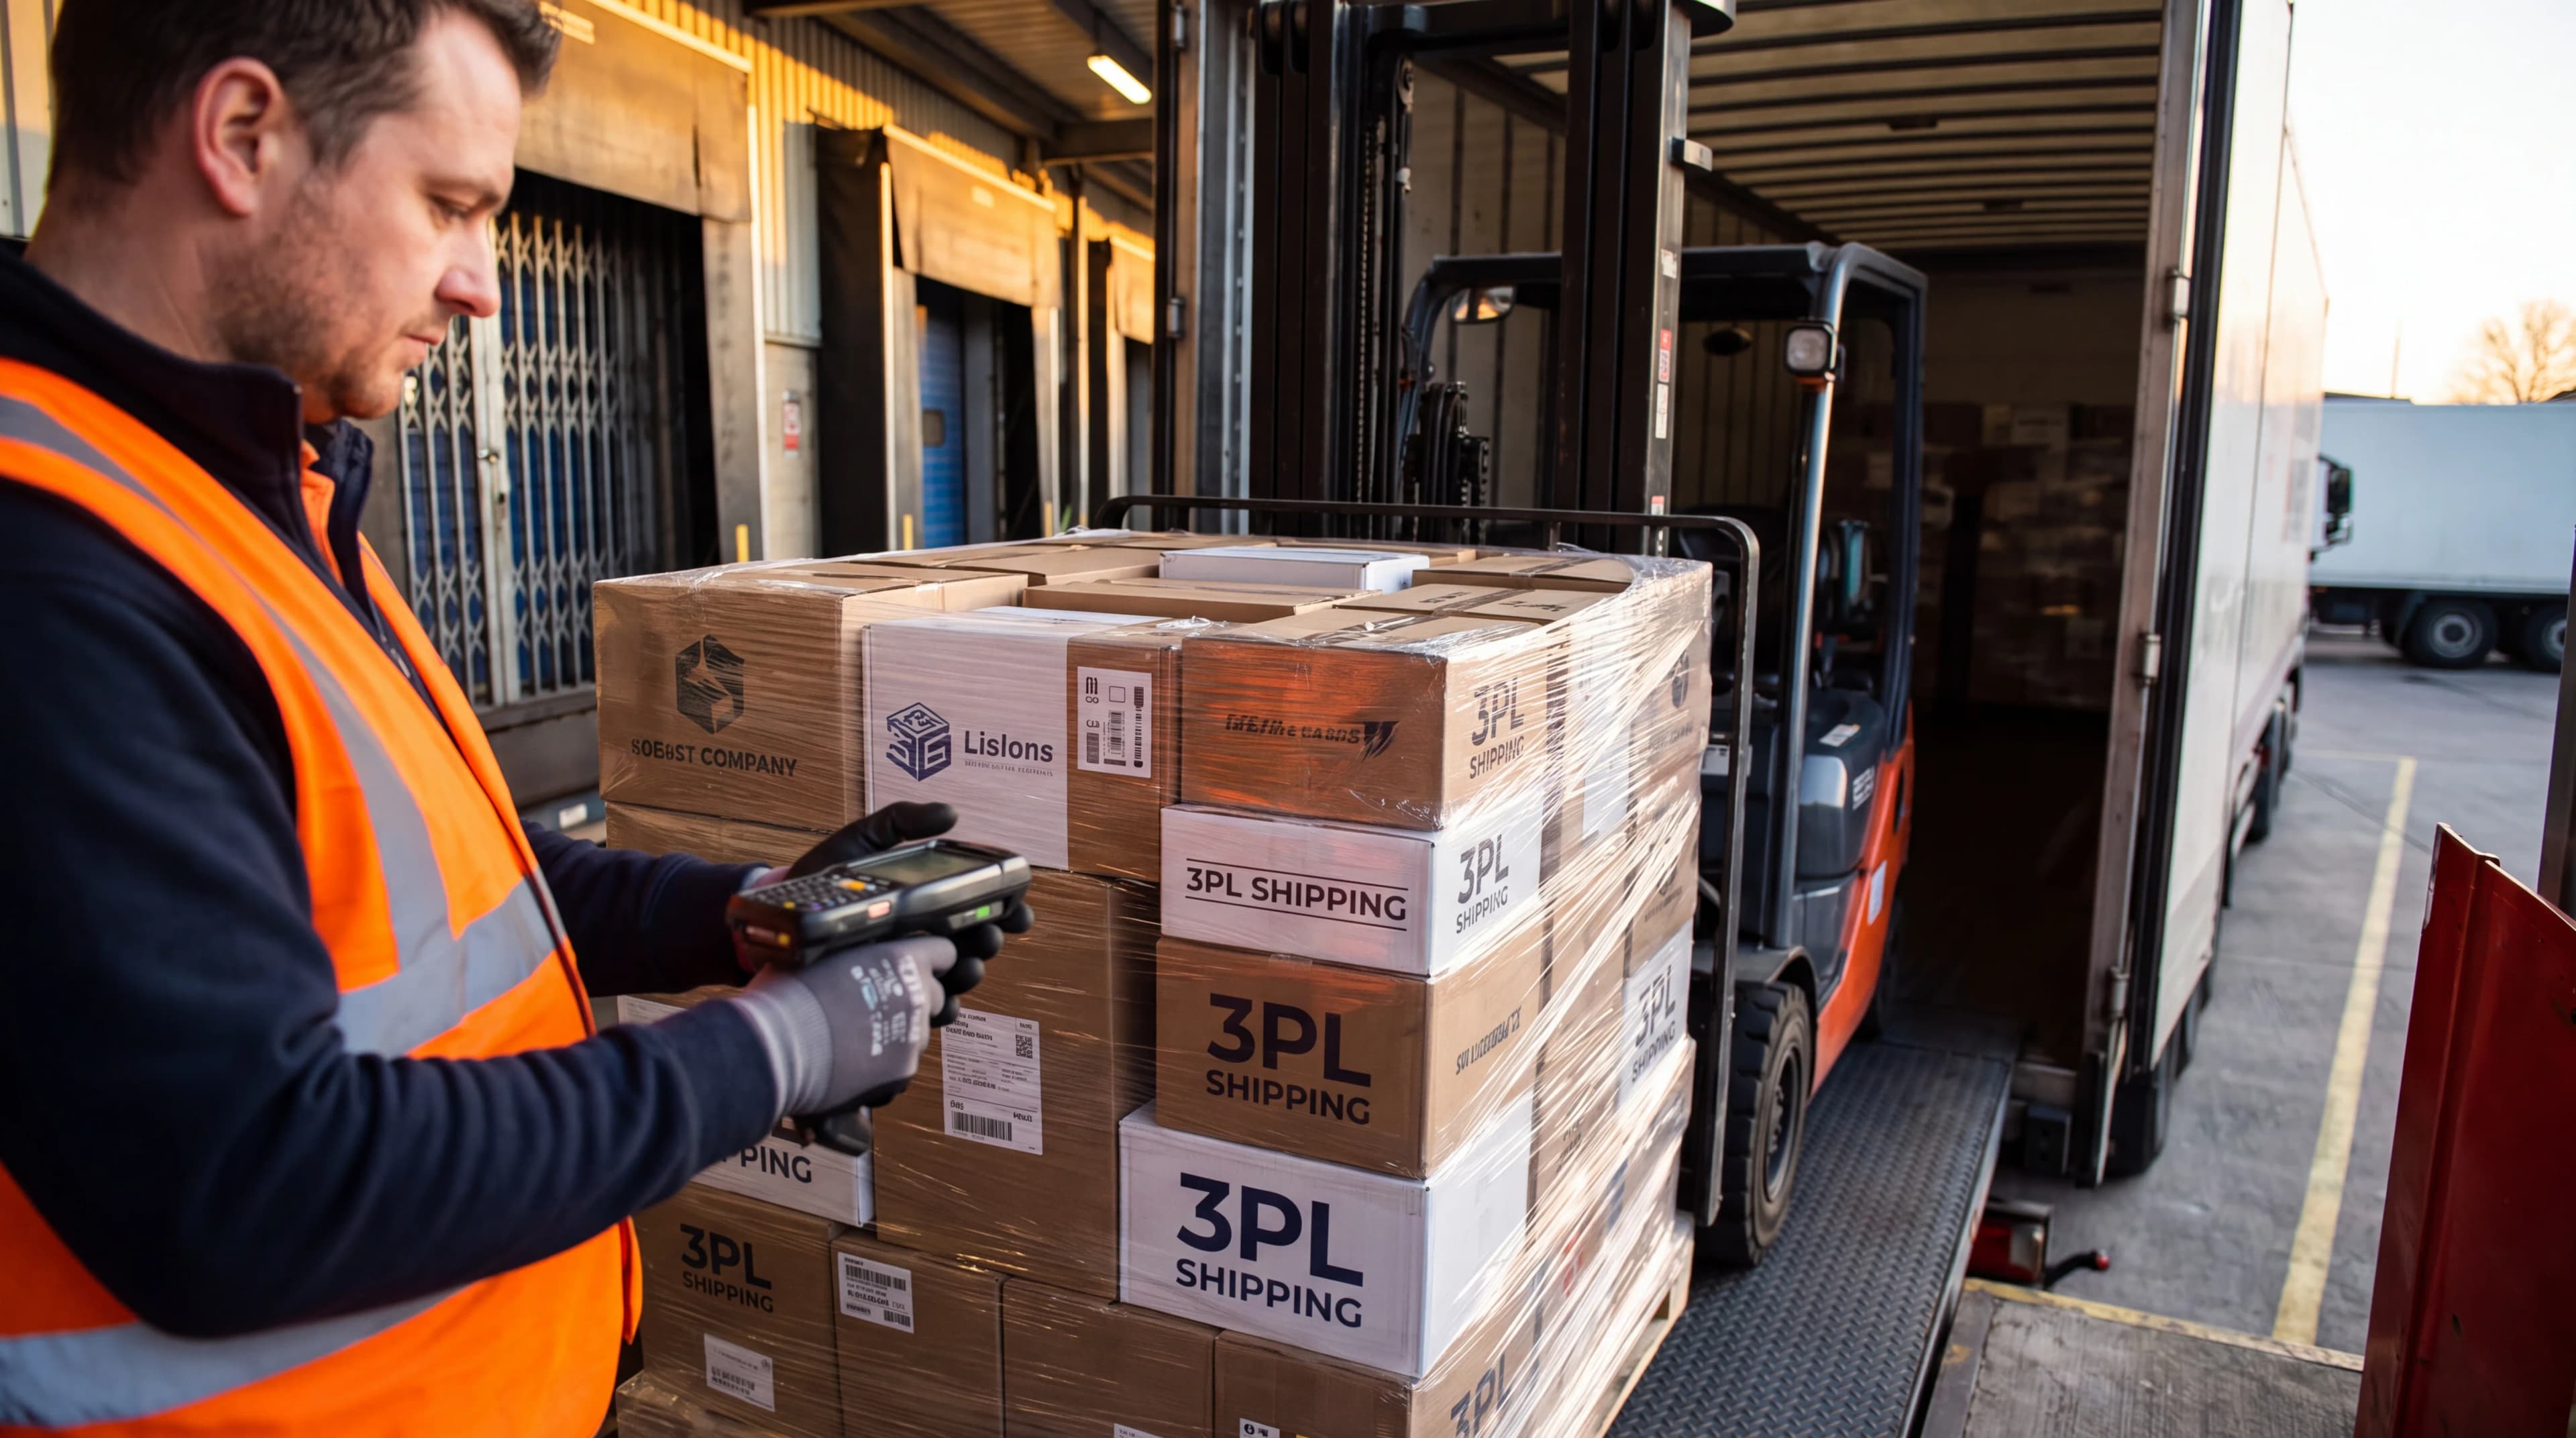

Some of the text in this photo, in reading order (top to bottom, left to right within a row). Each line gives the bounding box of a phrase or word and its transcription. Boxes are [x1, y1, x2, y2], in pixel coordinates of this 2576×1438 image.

[1472, 677, 1525, 746] 3PL
[700, 747, 797, 776] COMPANY
[1470, 735, 1524, 779] SHIPPING
[1187, 867, 1406, 921] 3PL SHIPPING
[1458, 834, 1509, 904] 3PL
[1456, 886, 1508, 933] SHIPPING
[1635, 964, 1676, 1047] 3PL
[1208, 993, 1371, 1087] 3PL
[1206, 1069, 1370, 1125] SHIPPING
[720, 1145, 812, 1184] PING
[680, 1223, 771, 1290] 3PL
[1177, 1172, 1363, 1287] 3PL
[683, 1270, 773, 1313] SHIPPING
[1176, 1258, 1362, 1328] SHIPPING
[1450, 1353, 1511, 1438] 3PL
